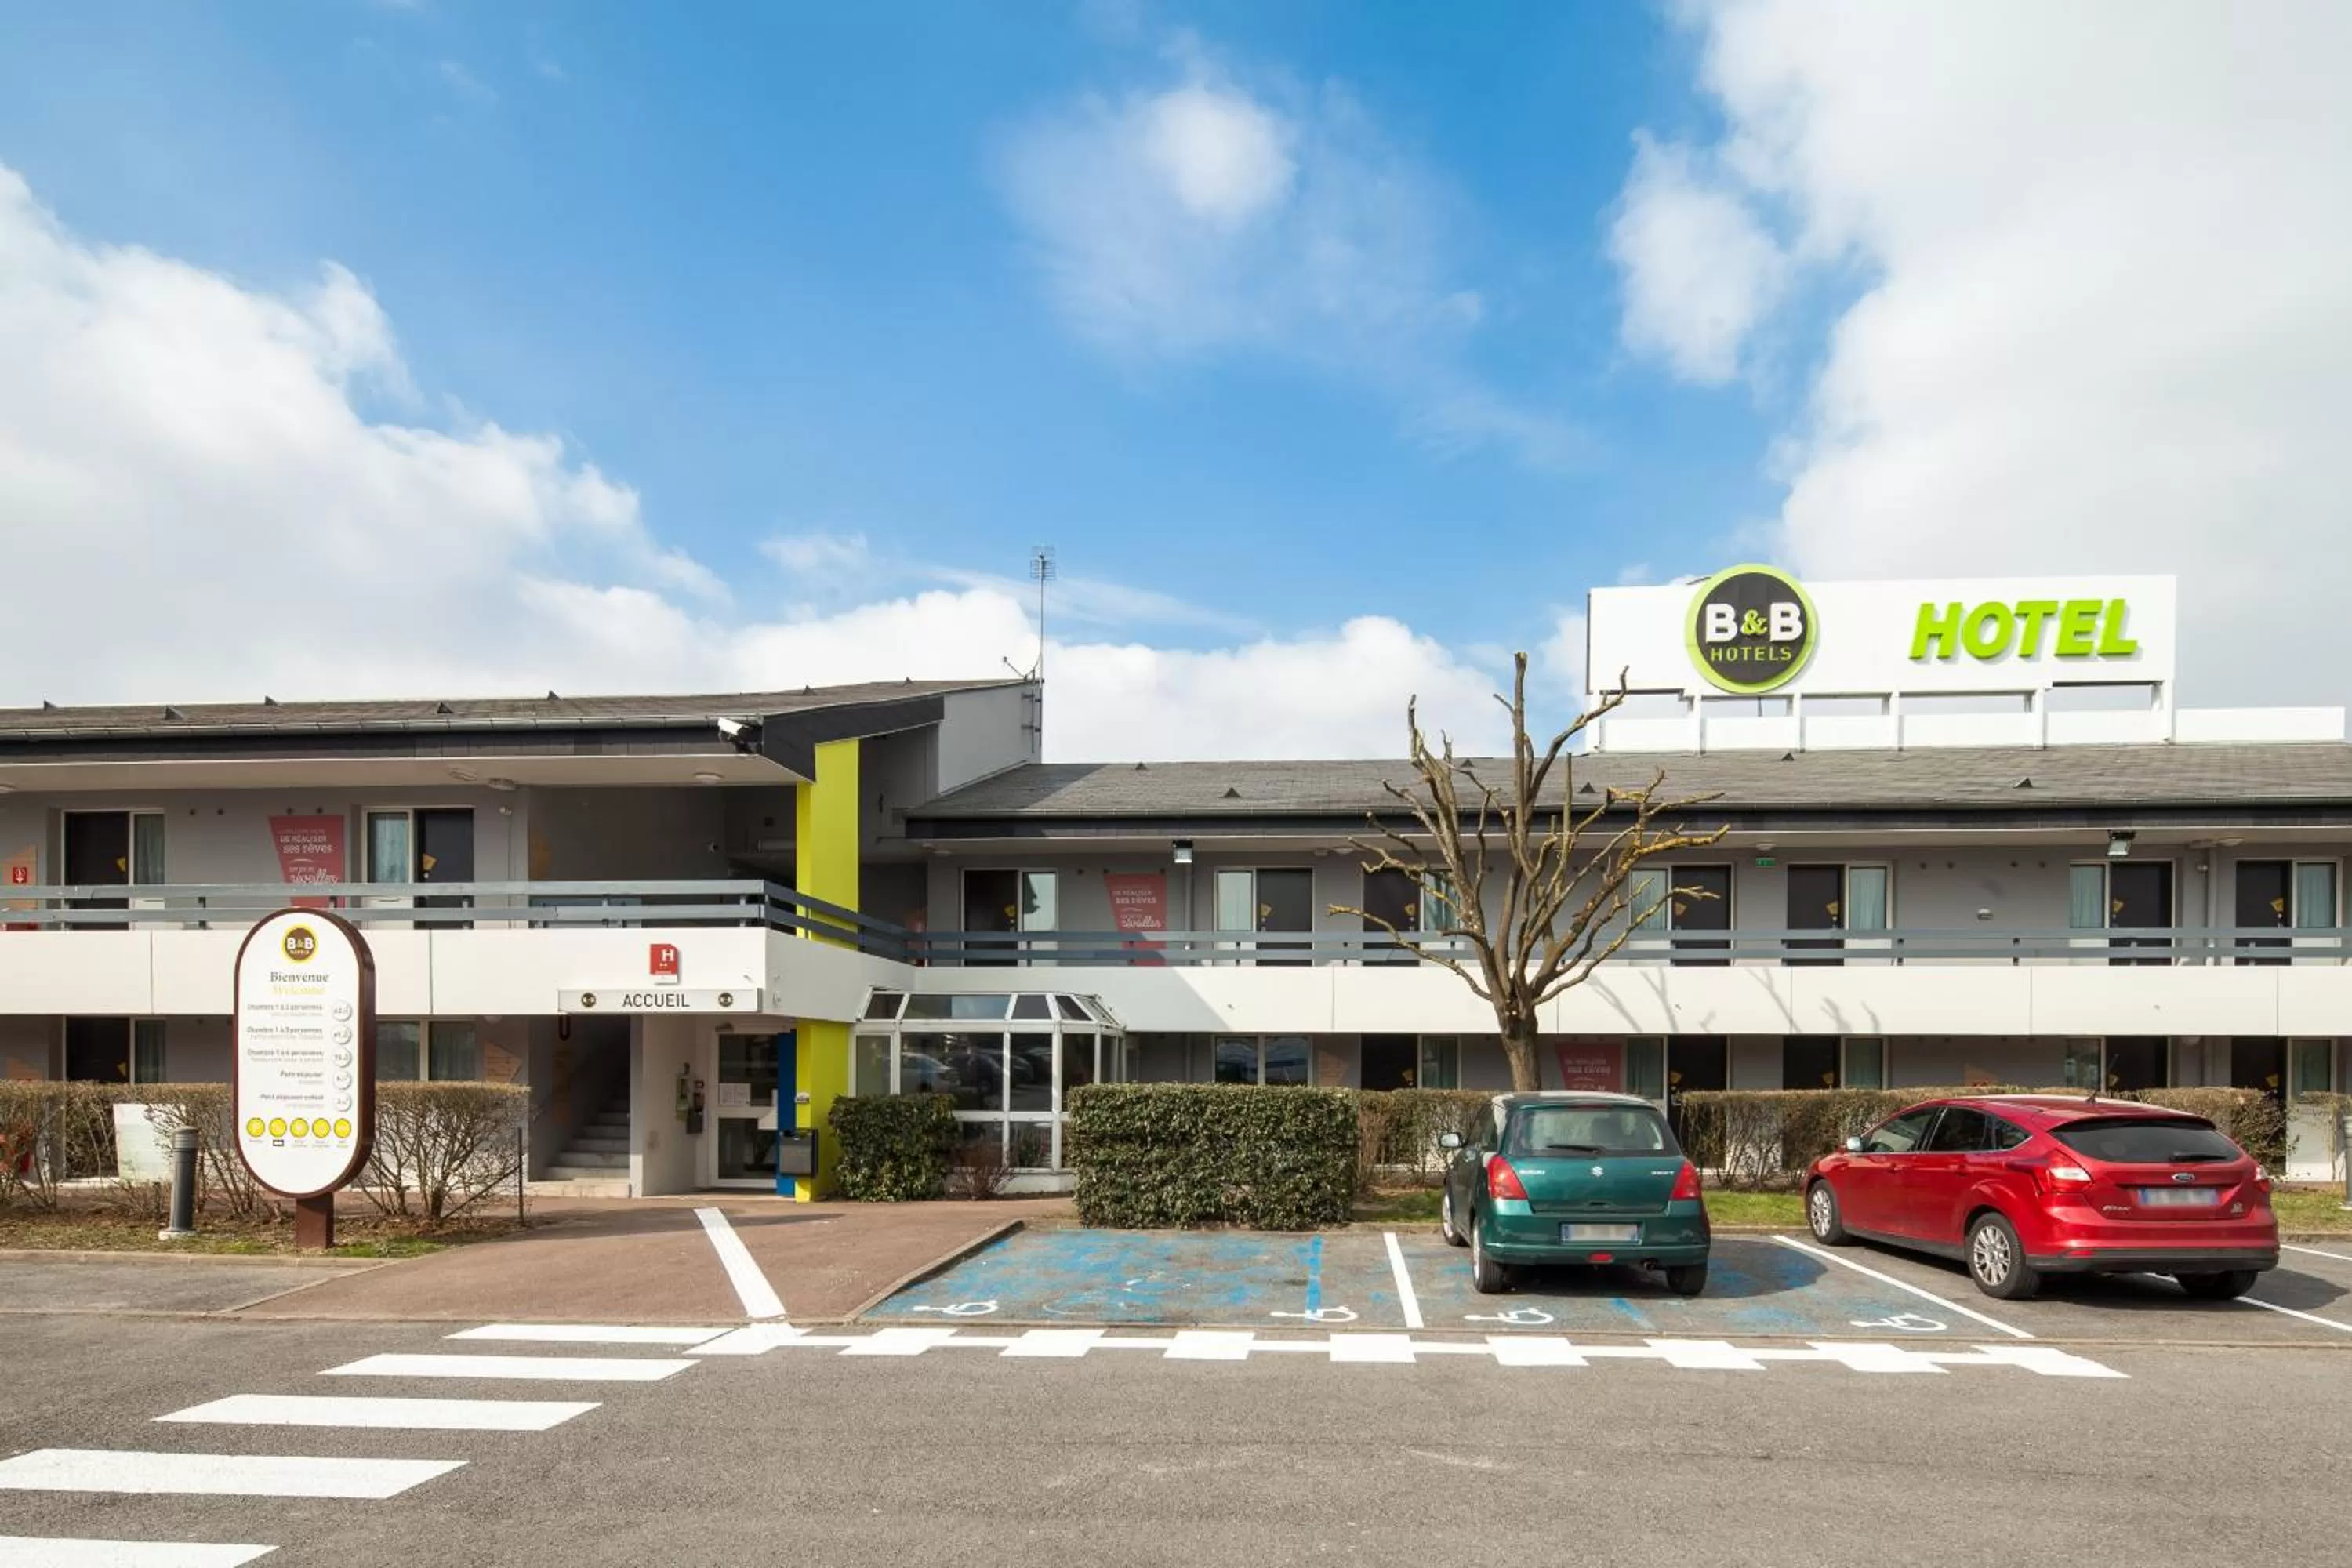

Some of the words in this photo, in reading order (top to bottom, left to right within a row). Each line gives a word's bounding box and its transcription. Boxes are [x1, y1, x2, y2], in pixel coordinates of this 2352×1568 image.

[1705, 602, 1803, 643] B&B
[1908, 599, 2138, 659] HOTEL
[1711, 647, 1792, 662] HOTELS
[286, 937, 314, 950] B&B
[661, 949, 675, 962] H
[270, 971, 330, 982] Bienvenue
[622, 993, 690, 1007] ACCUEIL
